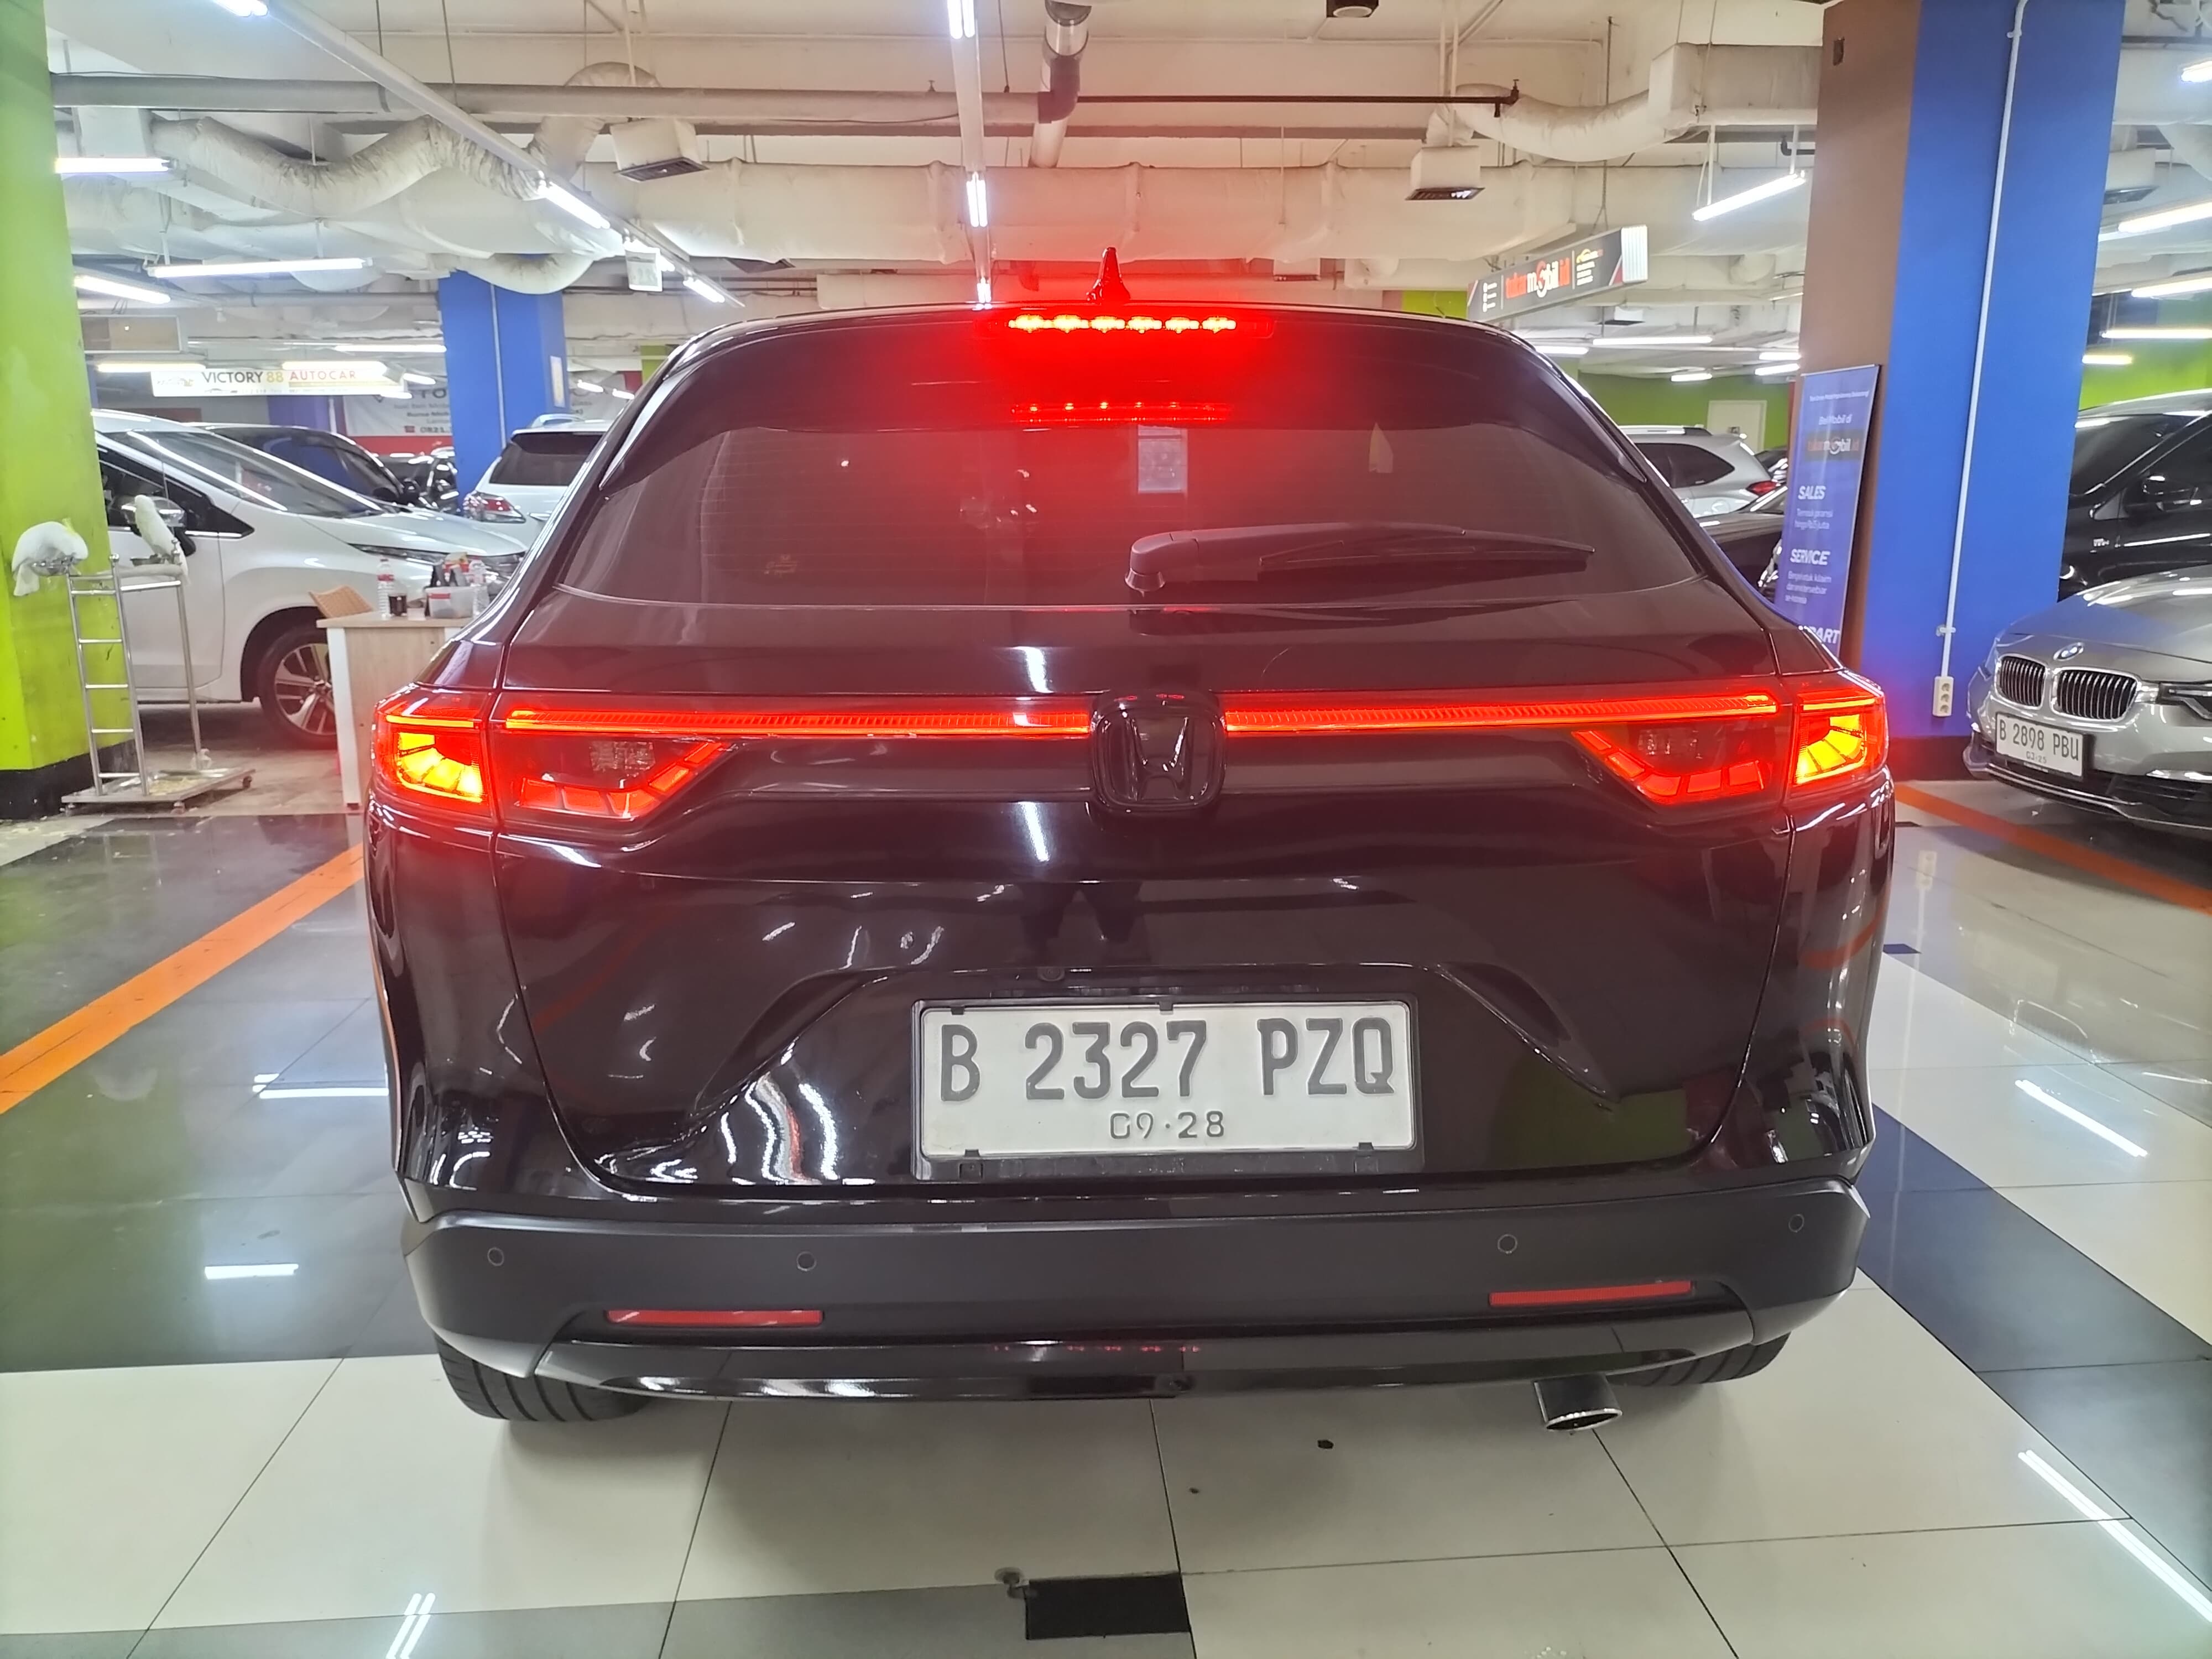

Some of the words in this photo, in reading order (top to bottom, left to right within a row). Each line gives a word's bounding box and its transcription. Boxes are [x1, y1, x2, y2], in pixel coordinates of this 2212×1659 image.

[202, 371, 263, 383] VICTORY
[266, 371, 284, 383] 88
[289, 371, 357, 380] AUTOCAR
[1798, 486, 1826, 500] SALES
[1790, 549, 1830, 565] SERVICE
[2000, 719, 2006, 741] B
[2013, 723, 2044, 751] 2898
[2053, 733, 2079, 761] PBU
[940, 1024, 980, 1102] B
[1024, 1019, 1208, 1100] 2327
[1256, 1017, 1395, 1096] PZQ
